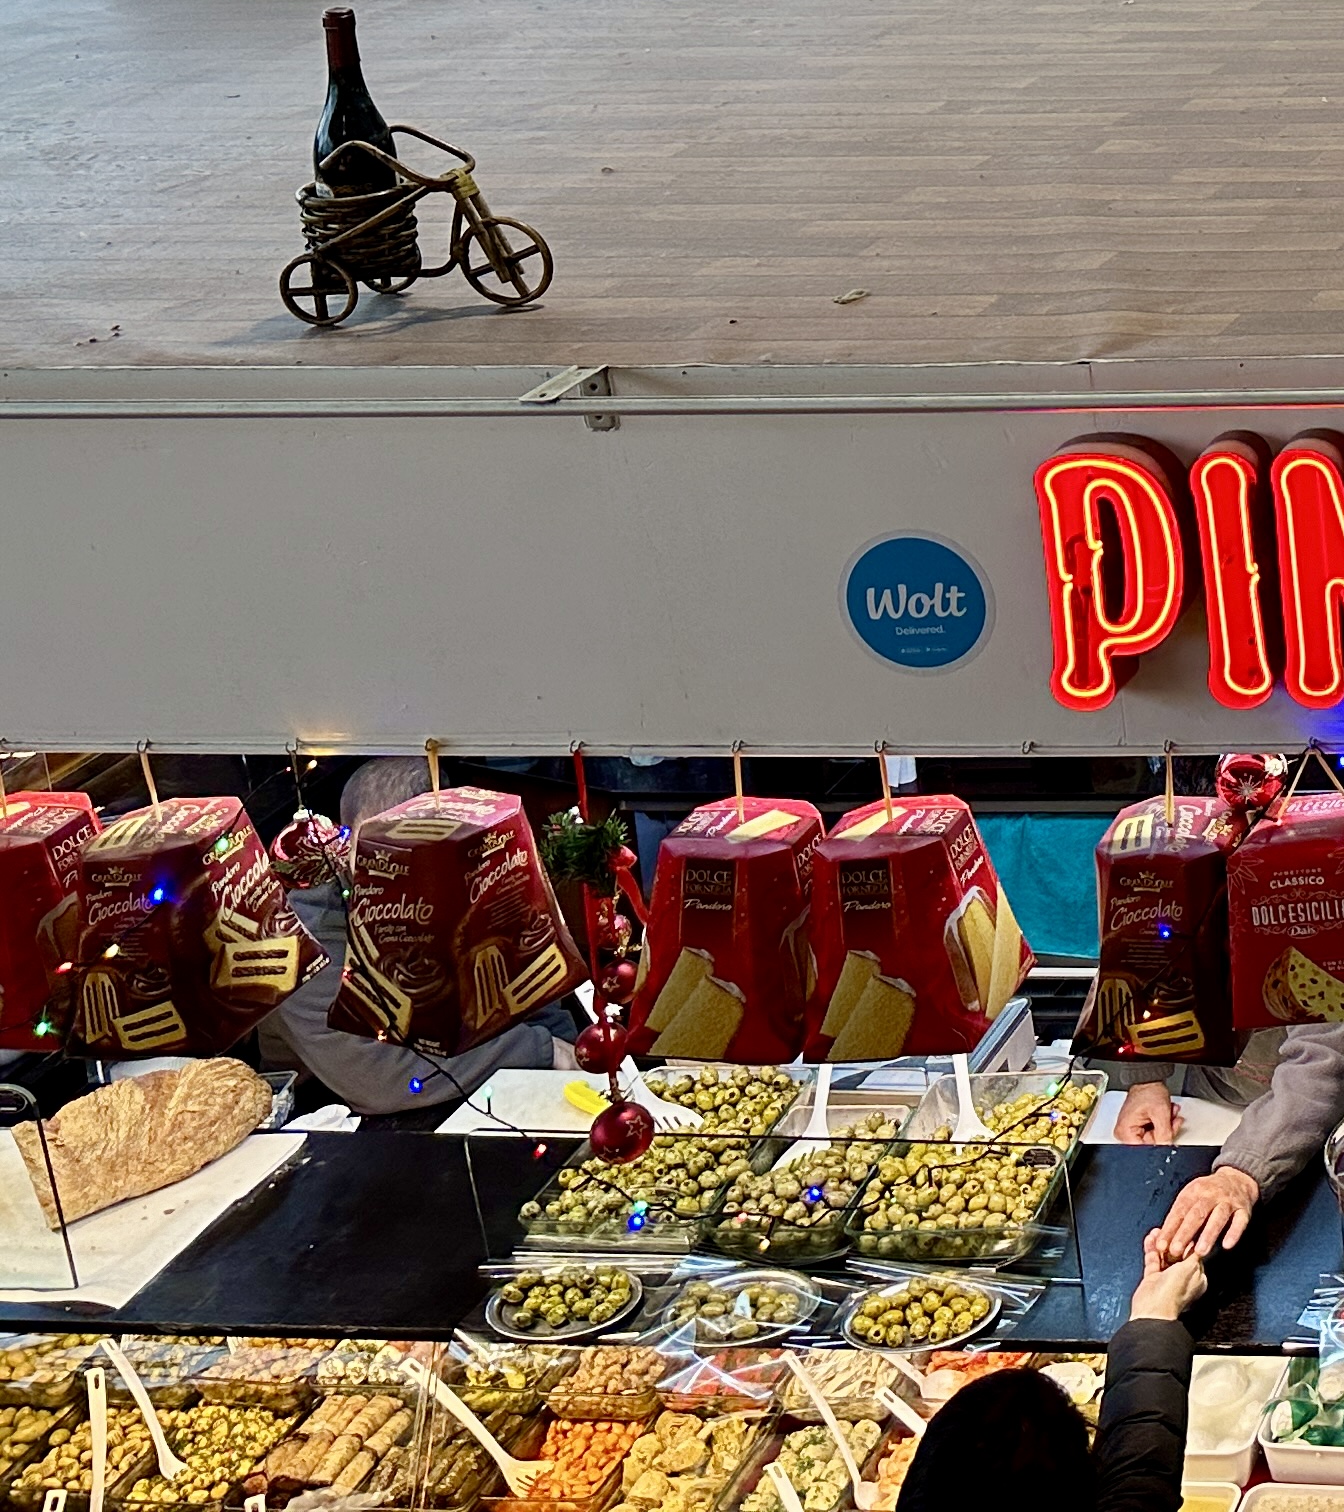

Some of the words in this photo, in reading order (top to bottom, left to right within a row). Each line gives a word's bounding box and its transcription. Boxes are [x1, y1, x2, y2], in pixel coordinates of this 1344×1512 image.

[866, 582, 967, 620] Wolt
[895, 625, 946, 636] Delivered.
[53, 823, 97, 861] DOLCE
[950, 823, 974, 860] DOLCE
[469, 848, 529, 904] Cioccolato
[685, 869, 732, 883] DOLCE
[841, 869, 888, 885] DOLCE
[1269, 876, 1325, 889] CLASSICO
[353, 882, 384, 903] Pandoro
[353, 893, 434, 927] Cioccolato
[684, 898, 732, 911] Pandoro
[843, 900, 891, 913] Pandoro
[1111, 898, 1183, 931] Cioccolato
